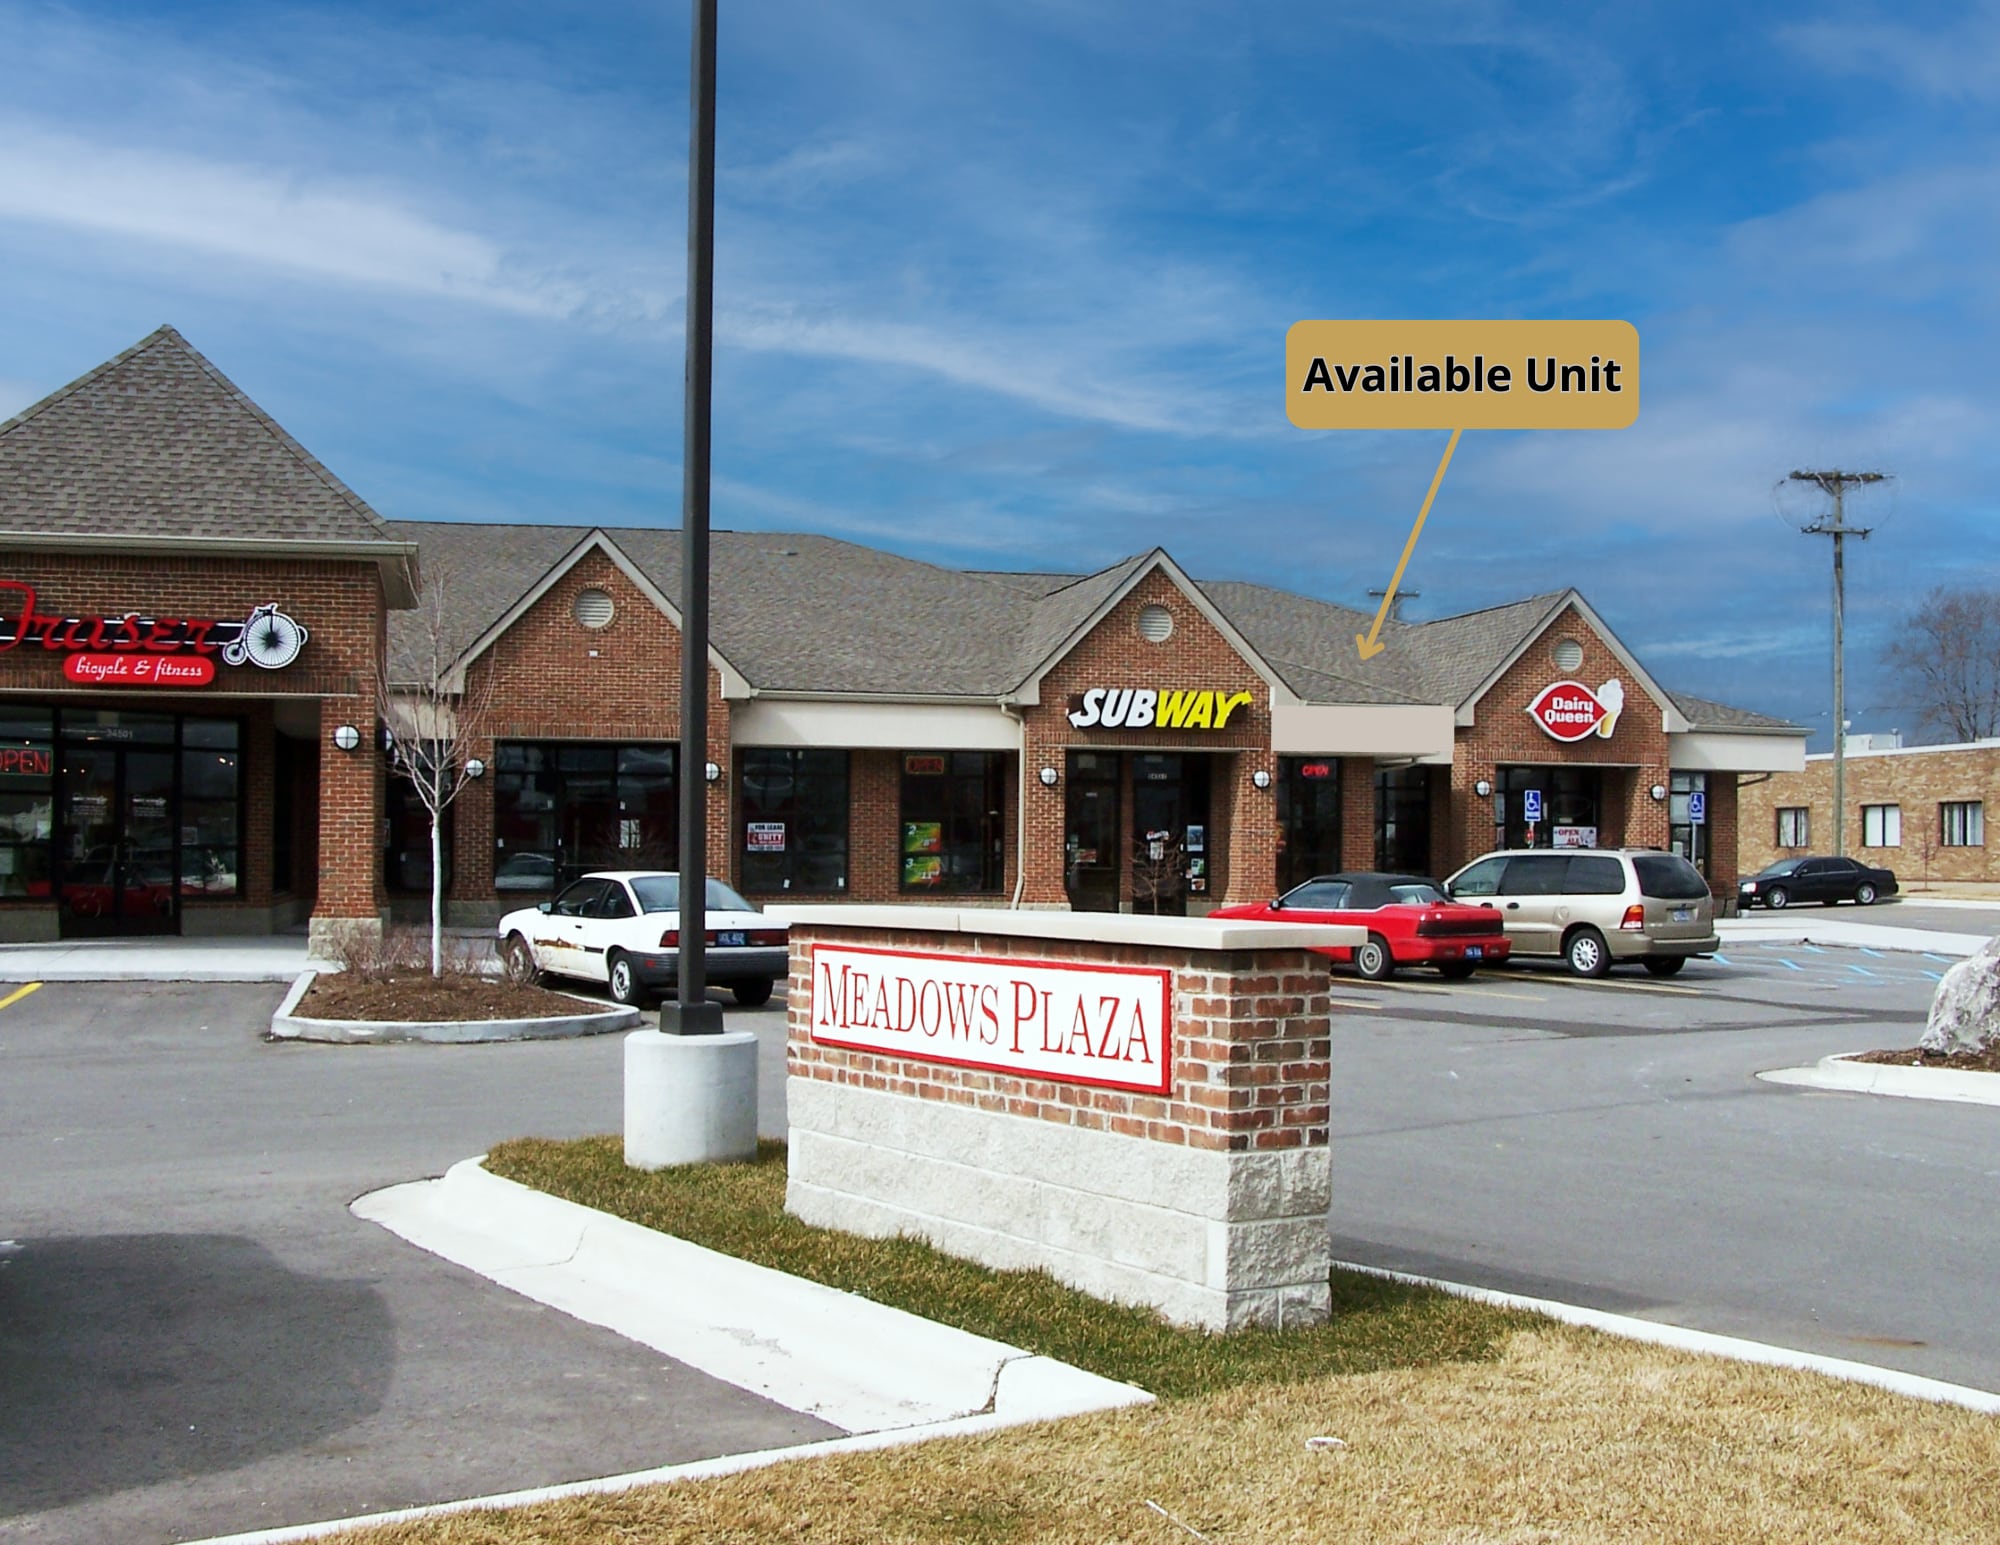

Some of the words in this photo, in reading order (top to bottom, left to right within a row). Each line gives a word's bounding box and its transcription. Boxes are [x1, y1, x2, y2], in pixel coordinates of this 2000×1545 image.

[75, 657, 128, 680] bicycle
[133, 660, 152, 676] &
[154, 659, 202, 681] fitness
[1068, 688, 1252, 729] SUBWAY
[1552, 696, 1594, 713] Dairy
[1544, 709, 1594, 725] Queen
[0, 750, 49, 774] PEN
[820, 962, 999, 1045] MEADOWS
[1009, 979, 1154, 1064] PLAZA
